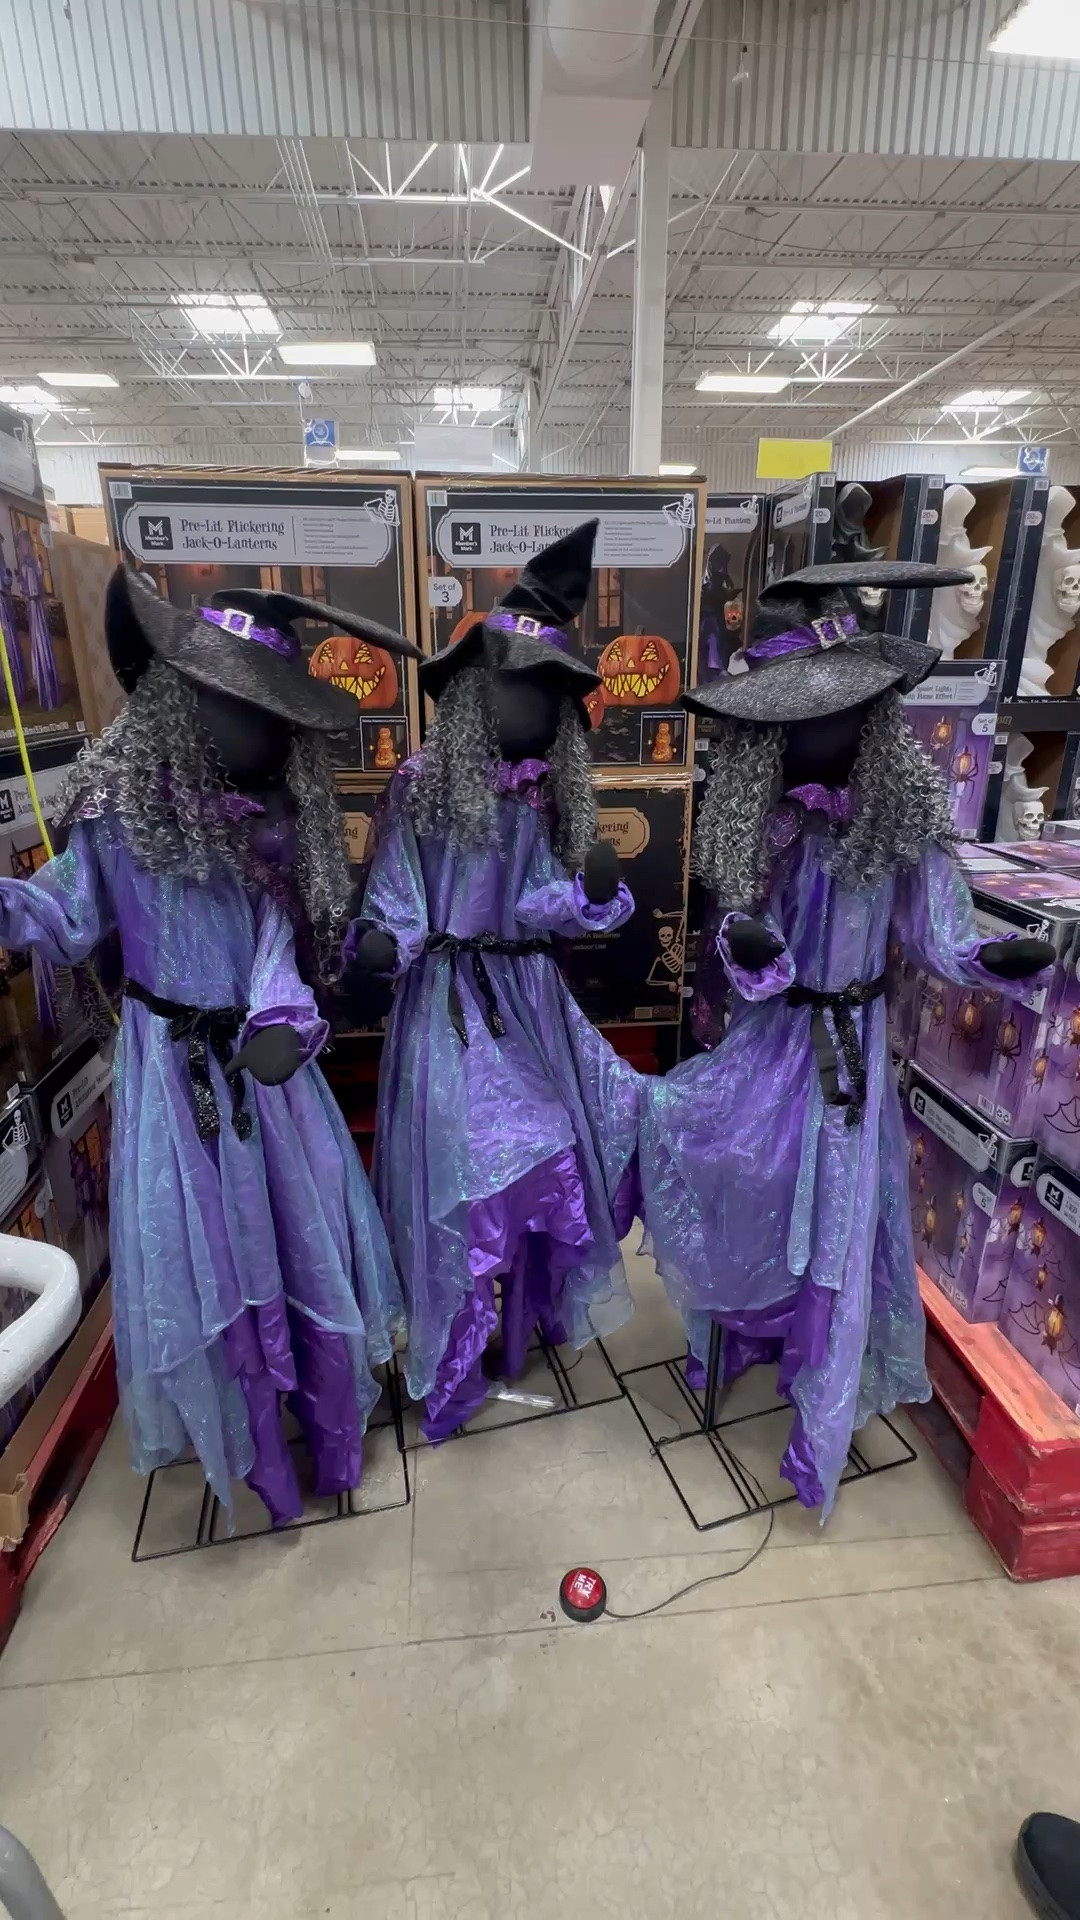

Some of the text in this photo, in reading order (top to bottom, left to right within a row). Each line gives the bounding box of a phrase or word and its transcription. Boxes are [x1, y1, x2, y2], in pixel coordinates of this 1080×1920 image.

[179, 519, 285, 536] Pre-Lit Flickering
[489, 524, 529, 537] Pre-Lit
[182, 537, 278, 551] Jack-O-Lanterns
[433, 583, 456, 591] Set of
[441, 591, 450, 603] 3
[981, 723, 989, 733] 5
[574, 1573, 587, 1592] ME
[583, 1576, 597, 1599] TRY
